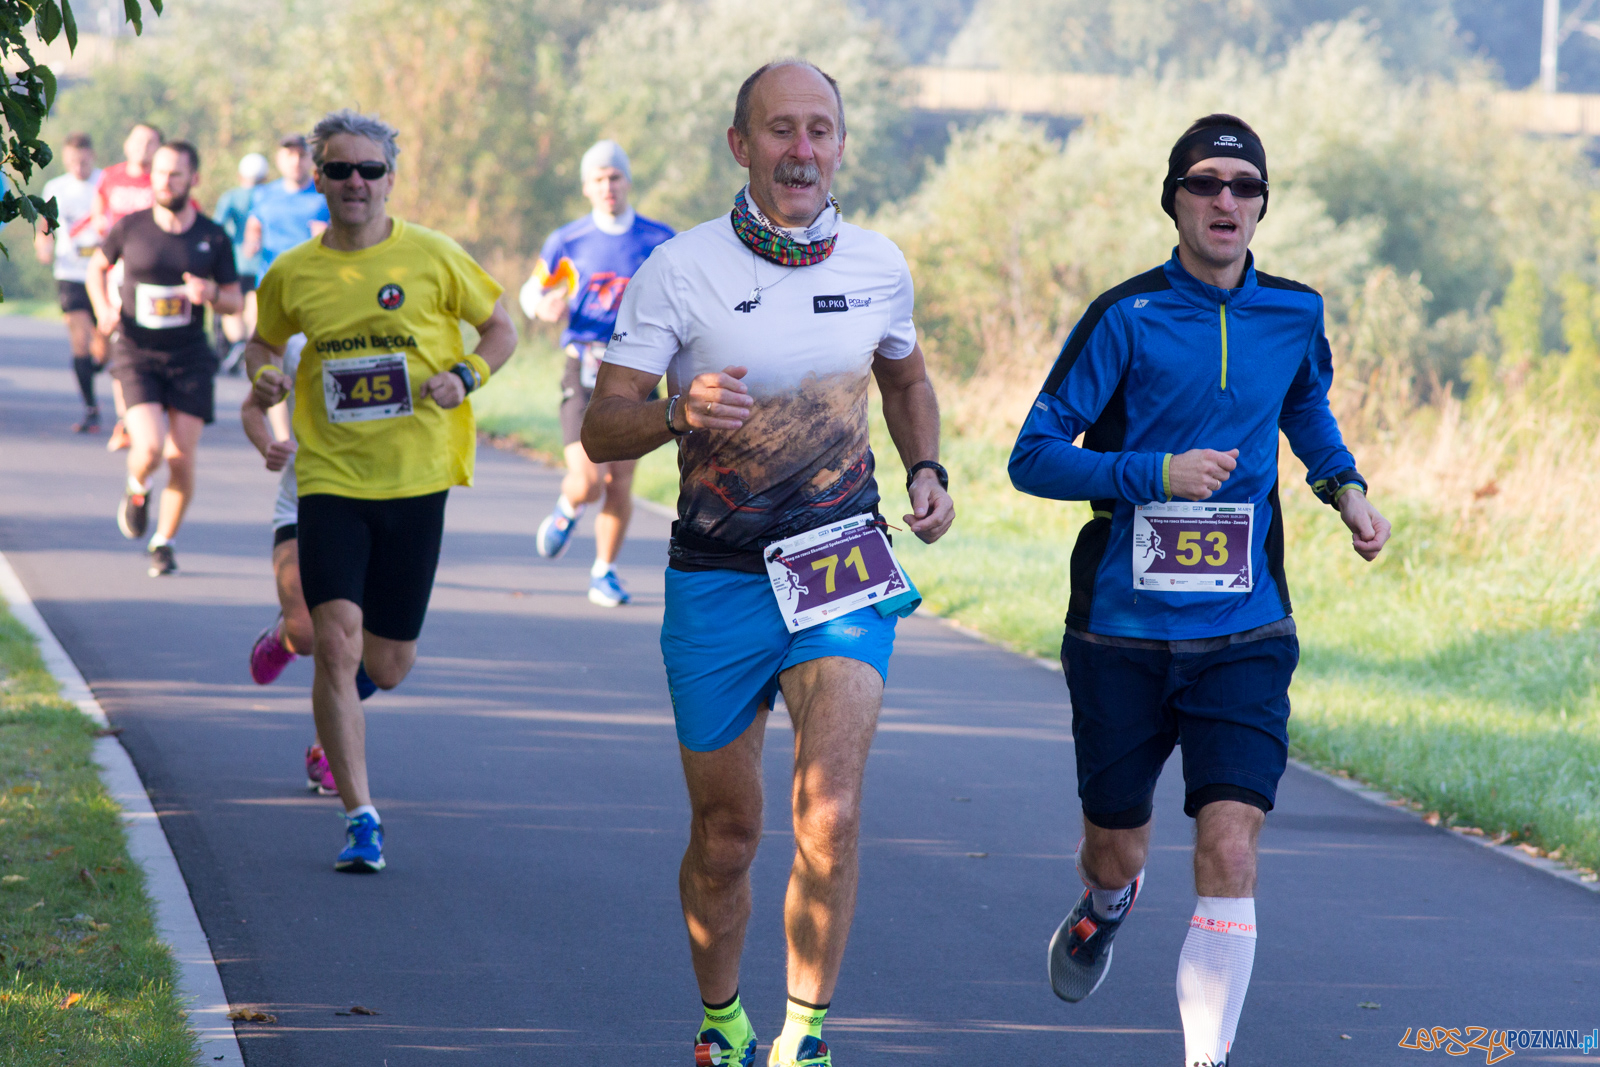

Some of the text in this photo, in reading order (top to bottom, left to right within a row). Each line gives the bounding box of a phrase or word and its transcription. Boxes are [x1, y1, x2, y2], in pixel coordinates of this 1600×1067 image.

[1213, 141, 1243, 149] Kalenji
[734, 300, 760, 313] 4F
[817, 300, 828, 308] 10.
[829, 300, 845, 308] PKO
[350, 375, 393, 403] 45
[1175, 531, 1229, 567] 53
[811, 545, 870, 594] 71
[844, 626, 868, 638] 4F
[1192, 915, 1256, 932] RESSPOR
